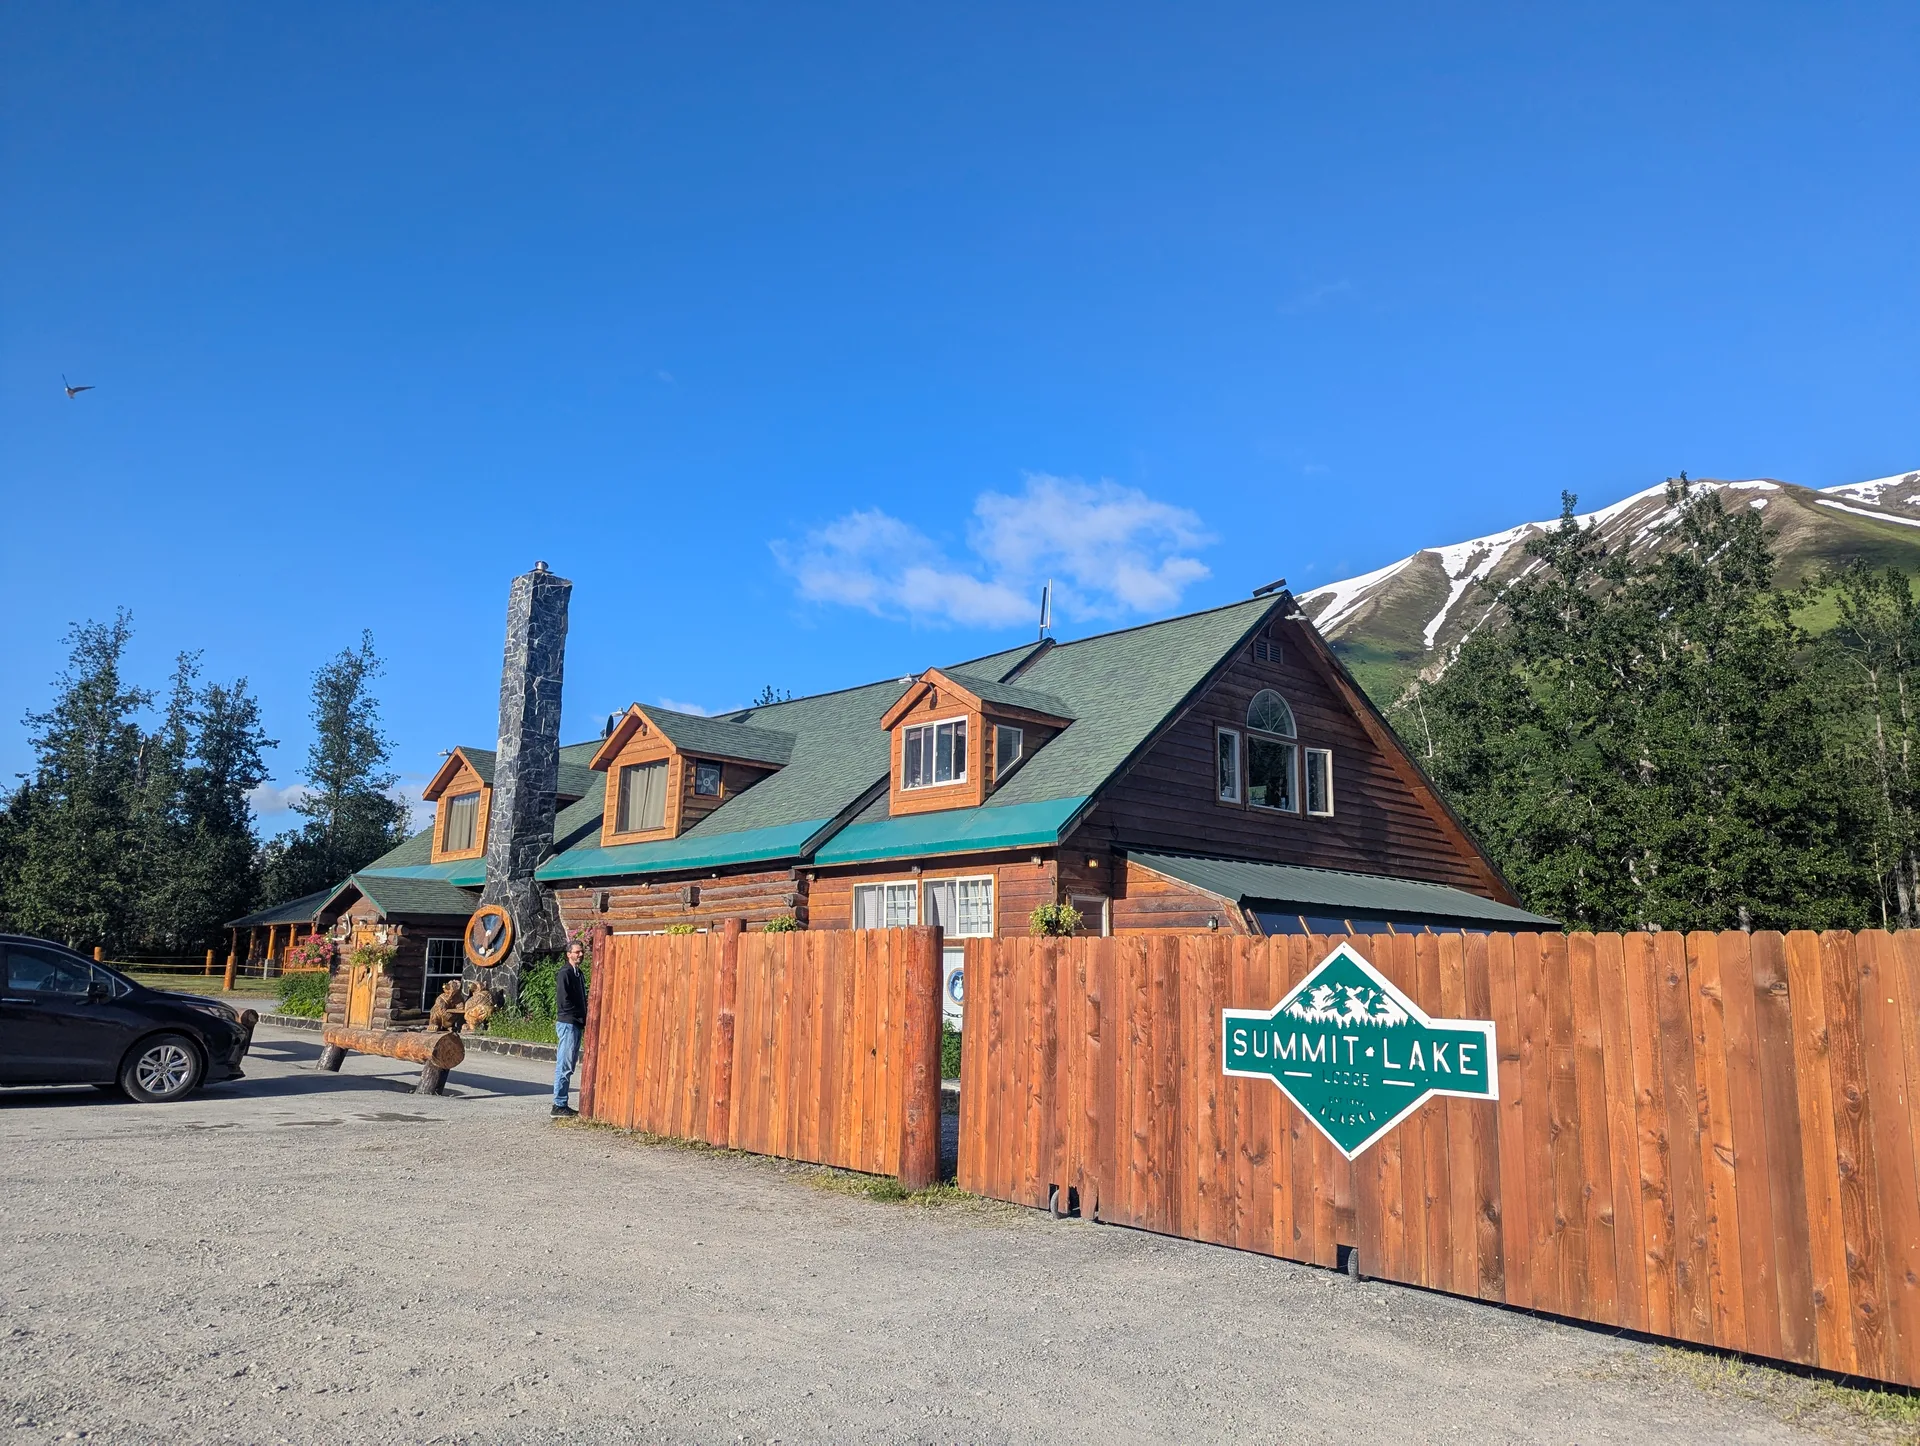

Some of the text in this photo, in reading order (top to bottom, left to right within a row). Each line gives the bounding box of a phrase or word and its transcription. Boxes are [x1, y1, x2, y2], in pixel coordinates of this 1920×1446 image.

[1233, 1029, 1479, 1076] SUMMIT LAKE
[1322, 1070, 1370, 1087] LODGE
[1318, 1104, 1376, 1126] ALASKA
